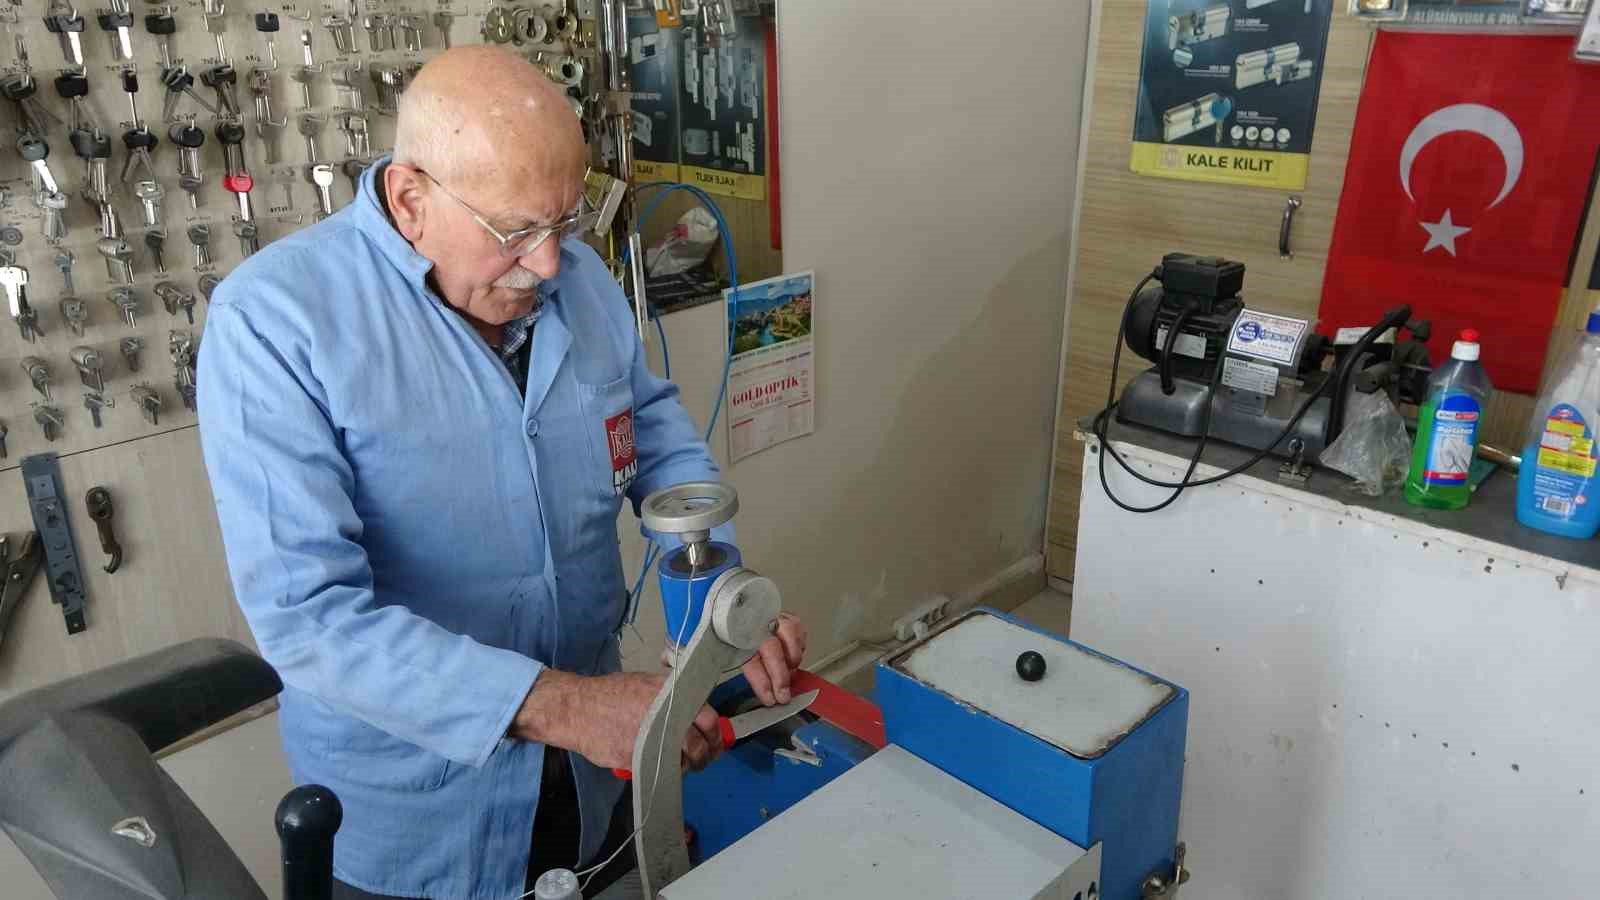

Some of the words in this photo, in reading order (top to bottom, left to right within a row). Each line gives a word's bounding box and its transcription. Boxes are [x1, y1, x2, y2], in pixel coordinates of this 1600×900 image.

[1187, 153, 1228, 169] KALE
[1233, 156, 1273, 172] KILIT
[732, 387, 763, 407] GOLD
